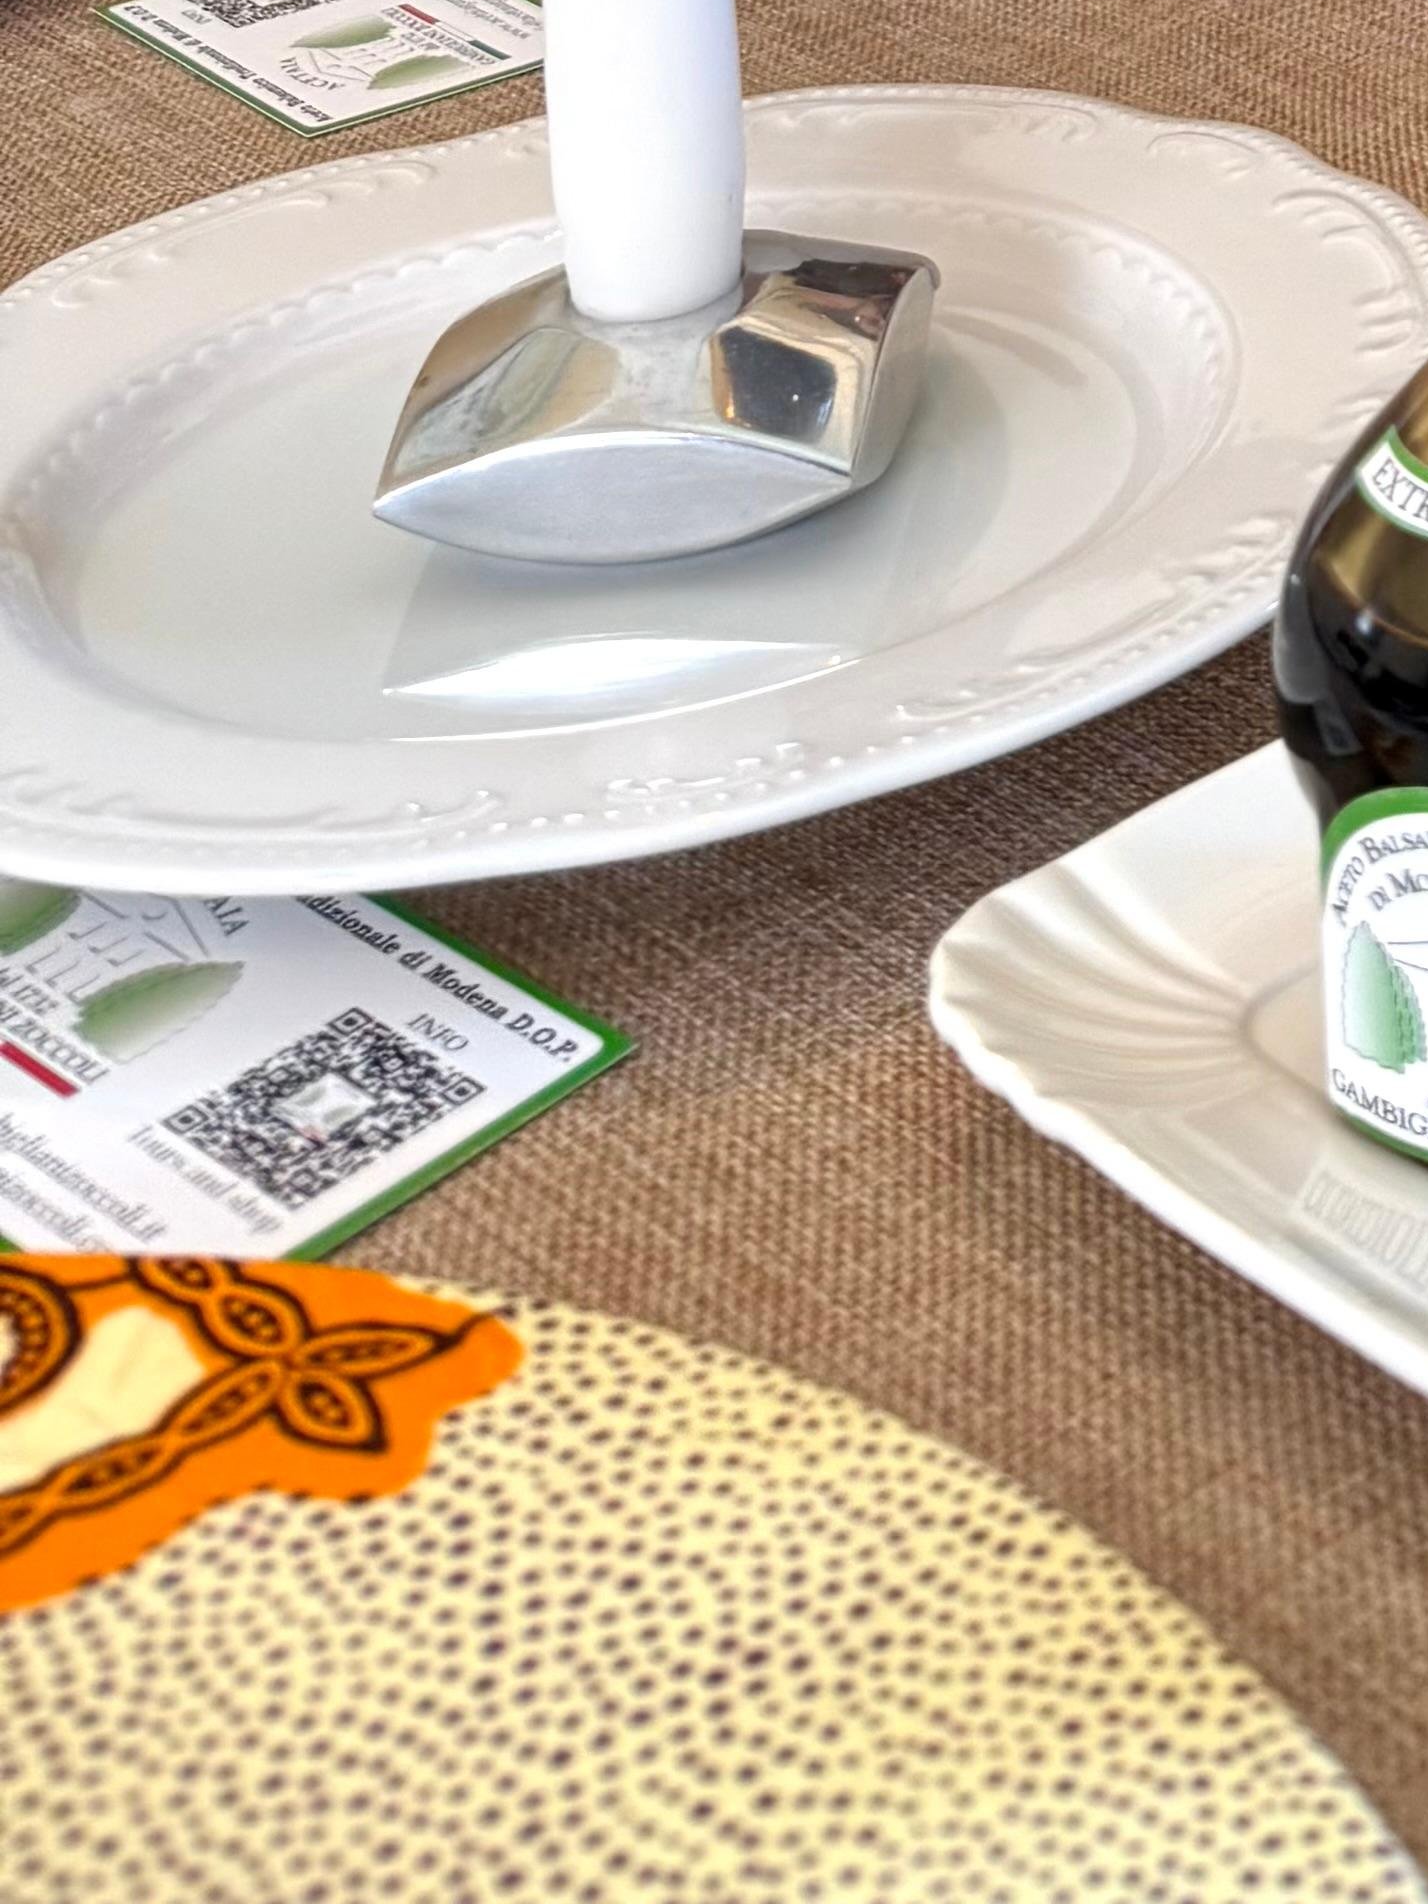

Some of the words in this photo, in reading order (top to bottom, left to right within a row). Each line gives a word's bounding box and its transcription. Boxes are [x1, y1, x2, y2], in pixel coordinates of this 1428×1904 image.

[398, 950, 434, 971] di
[421, 962, 510, 1021] Modena
[504, 1011, 580, 1063] D.O.P.
[406, 1012, 470, 1053] INFO
[15, 1019, 112, 1086] ZOCCOLI
